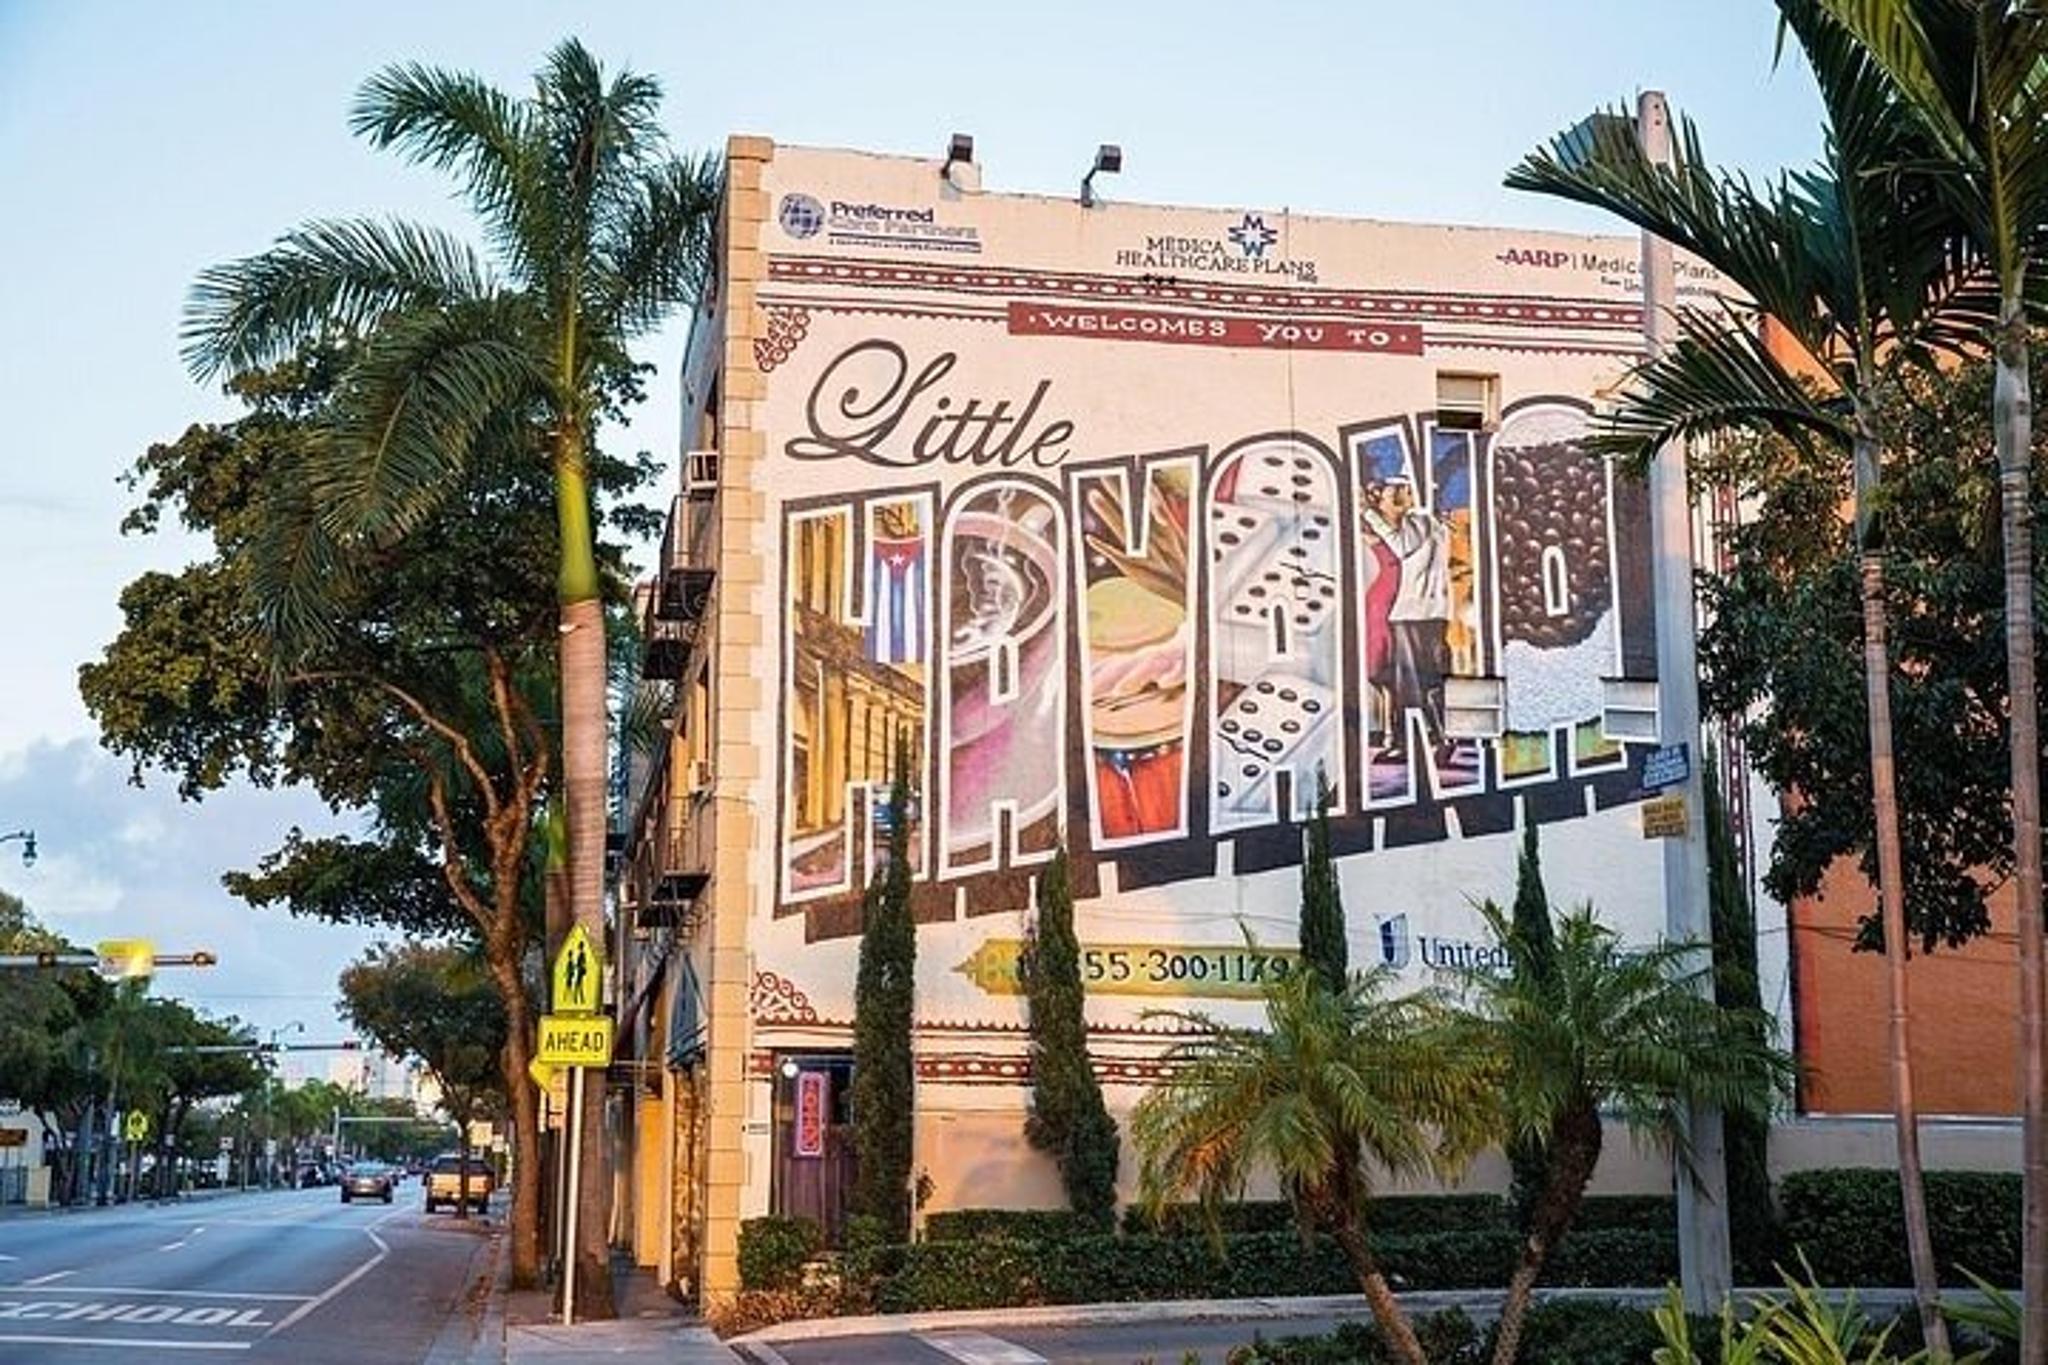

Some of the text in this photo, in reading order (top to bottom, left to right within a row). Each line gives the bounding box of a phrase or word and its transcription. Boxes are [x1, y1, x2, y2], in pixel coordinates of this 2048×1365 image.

[830, 200, 935, 223] Preferred
[1146, 236, 1226, 255] MEDICA
[1116, 250, 1316, 276] HEALTHCARE PLANS
[1503, 248, 1568, 269] AARP
[1038, 311, 1390, 346] WELCOMES YOU TO
[784, 338, 1075, 468] Little
[776, 396, 1630, 916] HAVANA
[545, 1031, 604, 1053] AHEAD
